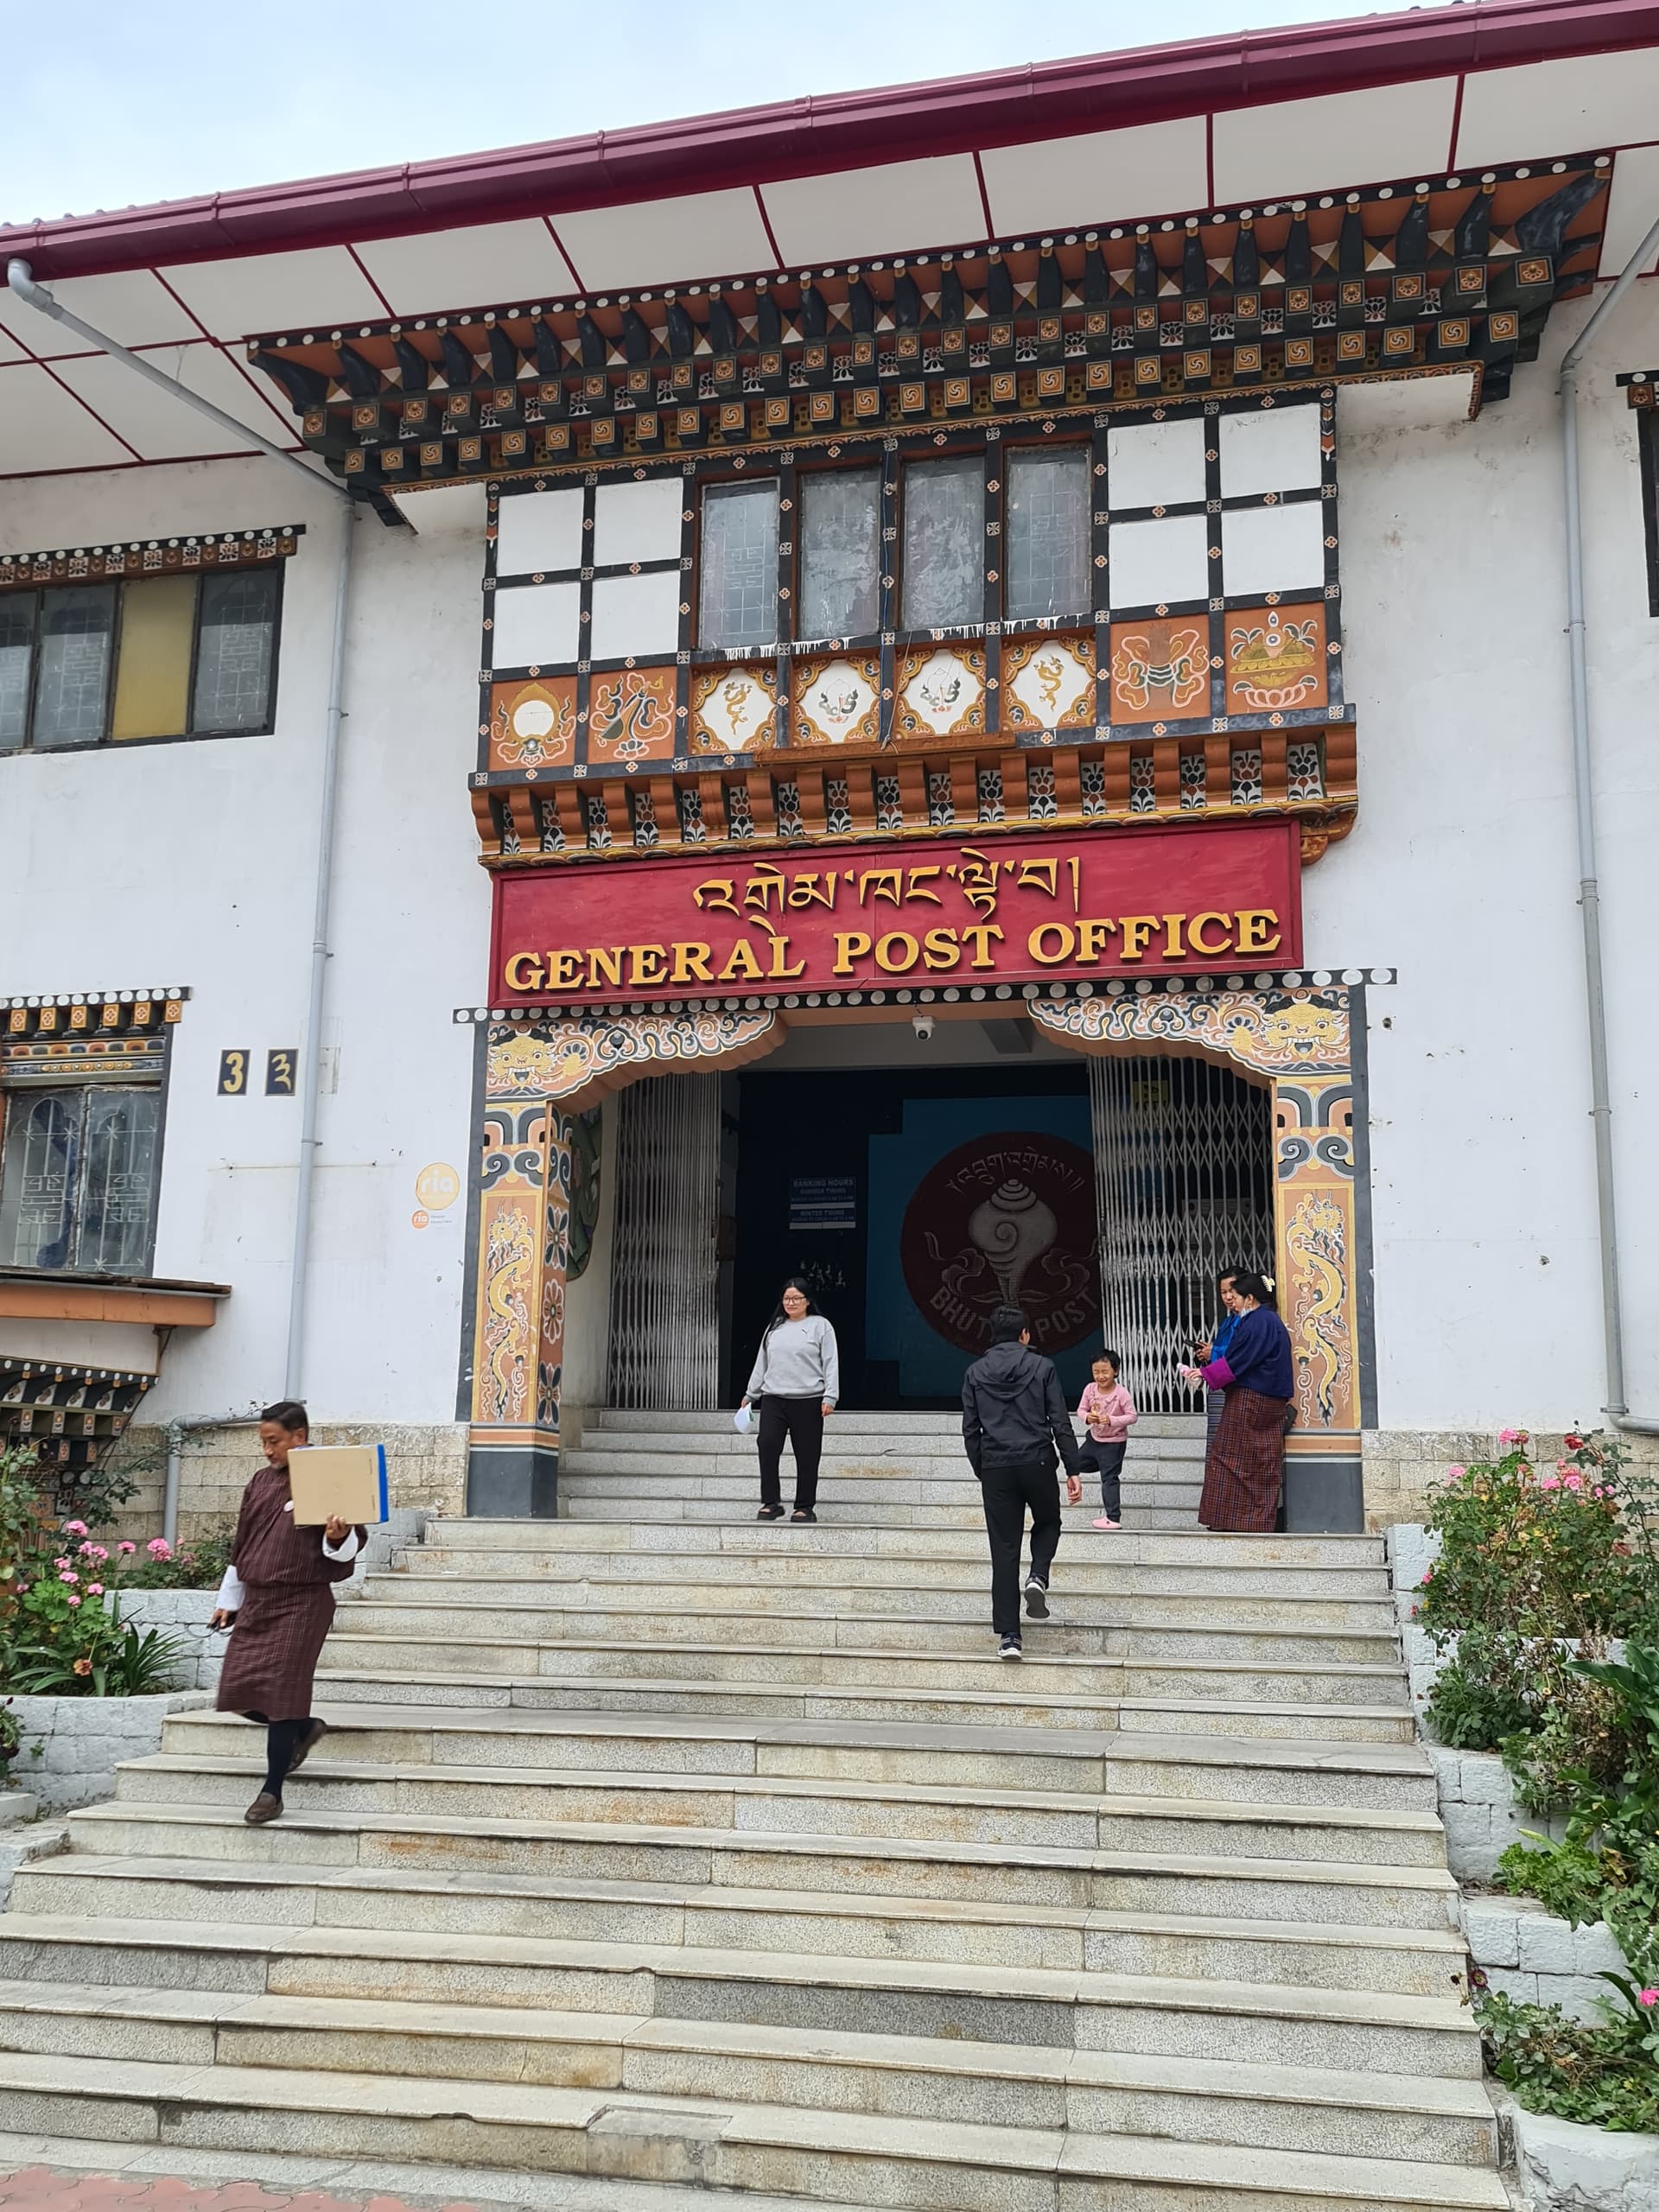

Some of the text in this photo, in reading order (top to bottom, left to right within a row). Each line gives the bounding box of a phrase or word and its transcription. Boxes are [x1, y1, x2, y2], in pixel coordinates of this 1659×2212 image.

[504, 909, 1282, 991] GENERAL POST OFFICE
[223, 1052, 245, 1093] 3
[421, 1168, 454, 1193] ria
[414, 1214, 429, 1224] ria
[929, 1286, 1097, 1342] BHUT POST
